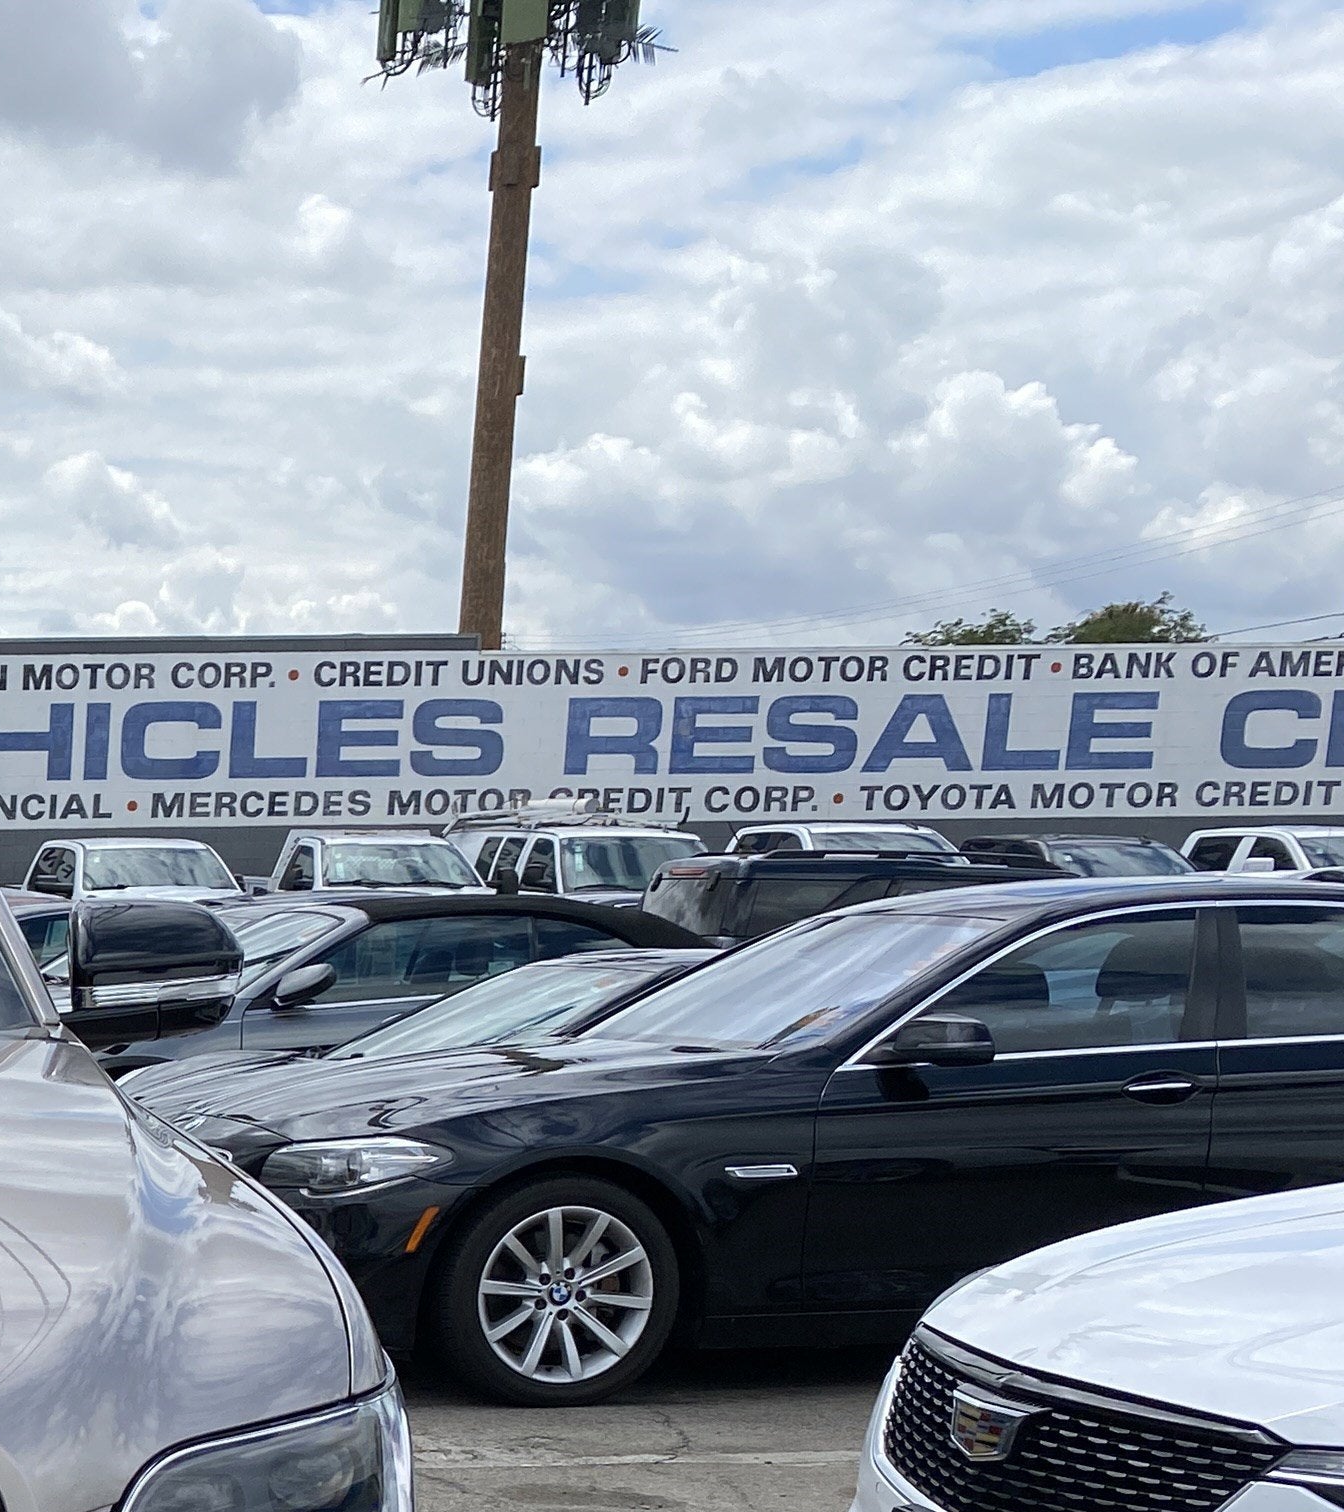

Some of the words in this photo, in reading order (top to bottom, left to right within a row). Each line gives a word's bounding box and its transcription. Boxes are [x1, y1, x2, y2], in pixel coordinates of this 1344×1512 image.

[22, 662, 156, 691] MOTOR
[171, 661, 276, 689] CORP.
[313, 660, 448, 688] CREDIT
[462, 658, 605, 686] UNIONS
[639, 657, 739, 684] FORD
[751, 655, 889, 683] MOTOR
[902, 653, 1041, 682] CREDIT
[1071, 652, 1178, 680] BANK
[1191, 651, 1240, 678] OF
[564, 691, 1160, 776] RESALE
[1220, 689, 1344, 769] C
[150, 789, 372, 819] MERCEDES
[386, 788, 532, 816] MOTOR
[703, 785, 818, 813] CORP.
[859, 783, 1017, 812] TOYOTA
[1030, 781, 1179, 809] MOTOR
[1195, 780, 1342, 807] CREDIT
